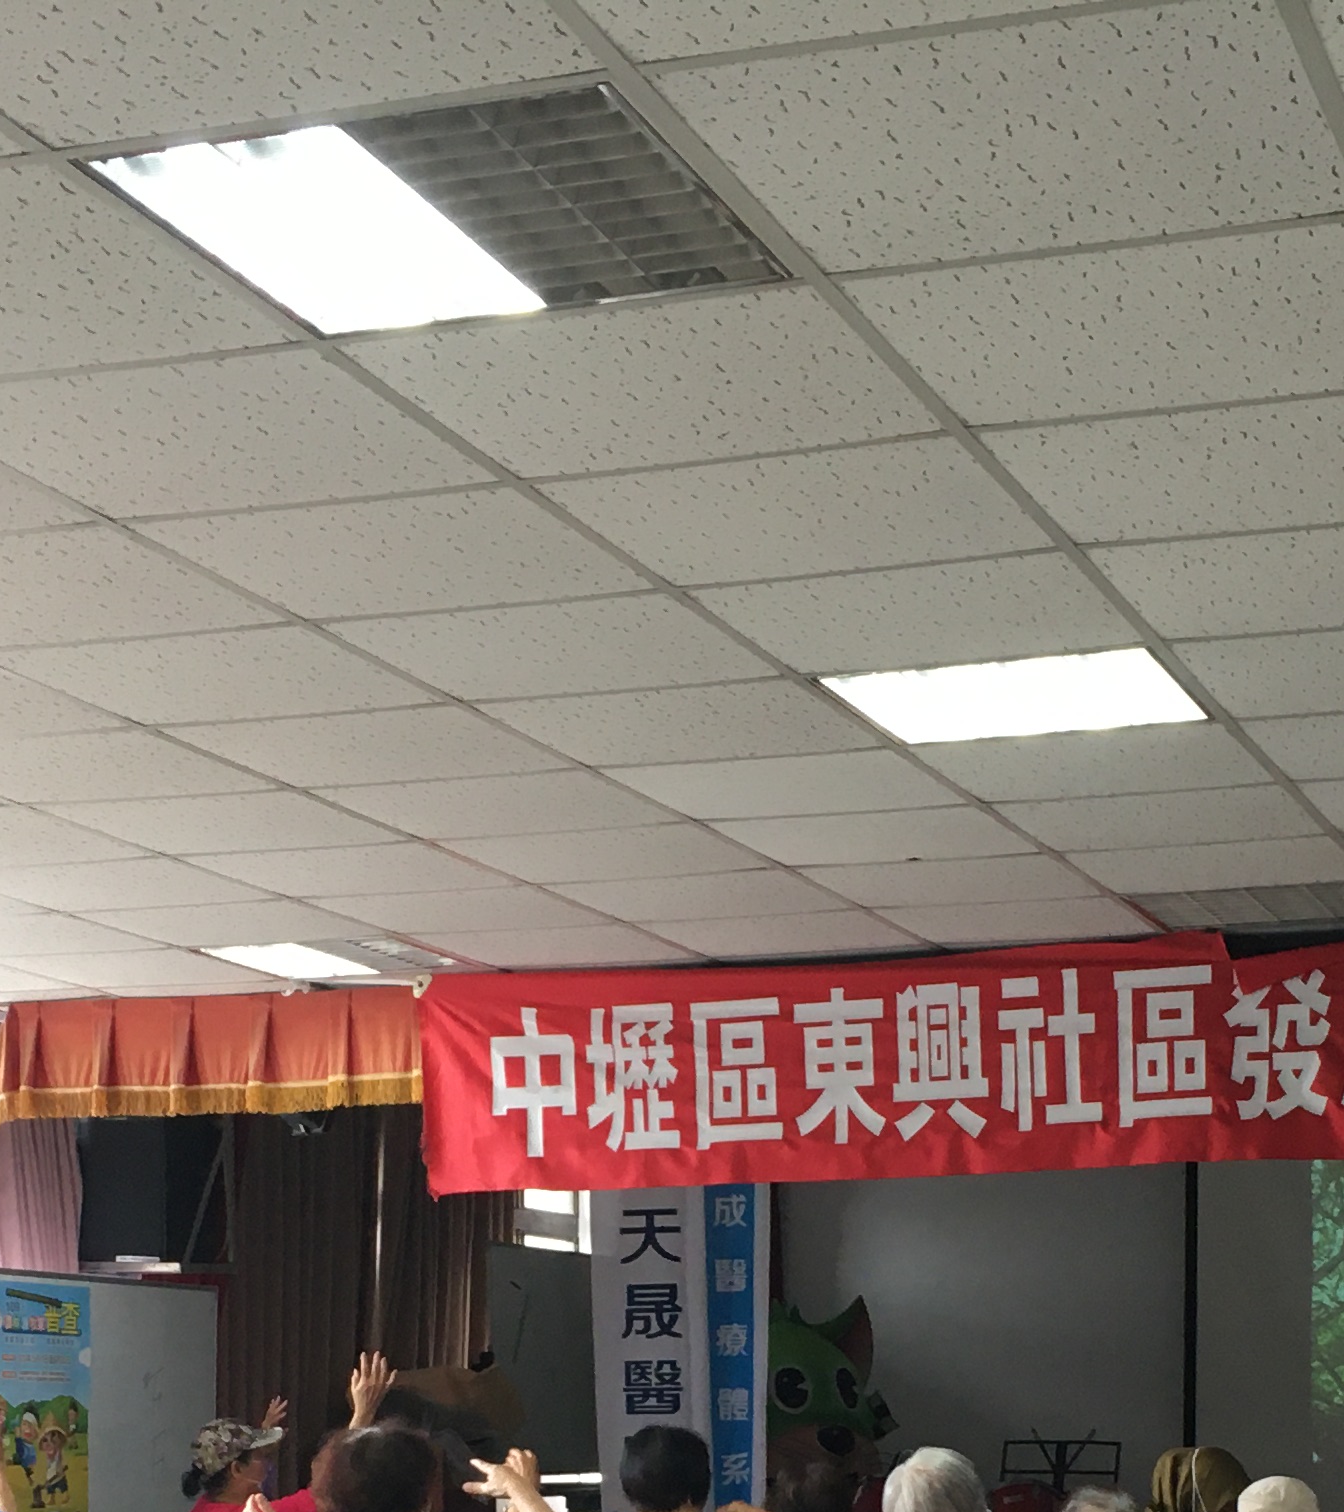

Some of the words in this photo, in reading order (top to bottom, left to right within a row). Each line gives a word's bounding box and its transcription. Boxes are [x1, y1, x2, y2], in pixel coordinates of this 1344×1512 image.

[619, 1207, 684, 1440] 天晟醫
[712, 1193, 751, 1486] 成醫療體系
